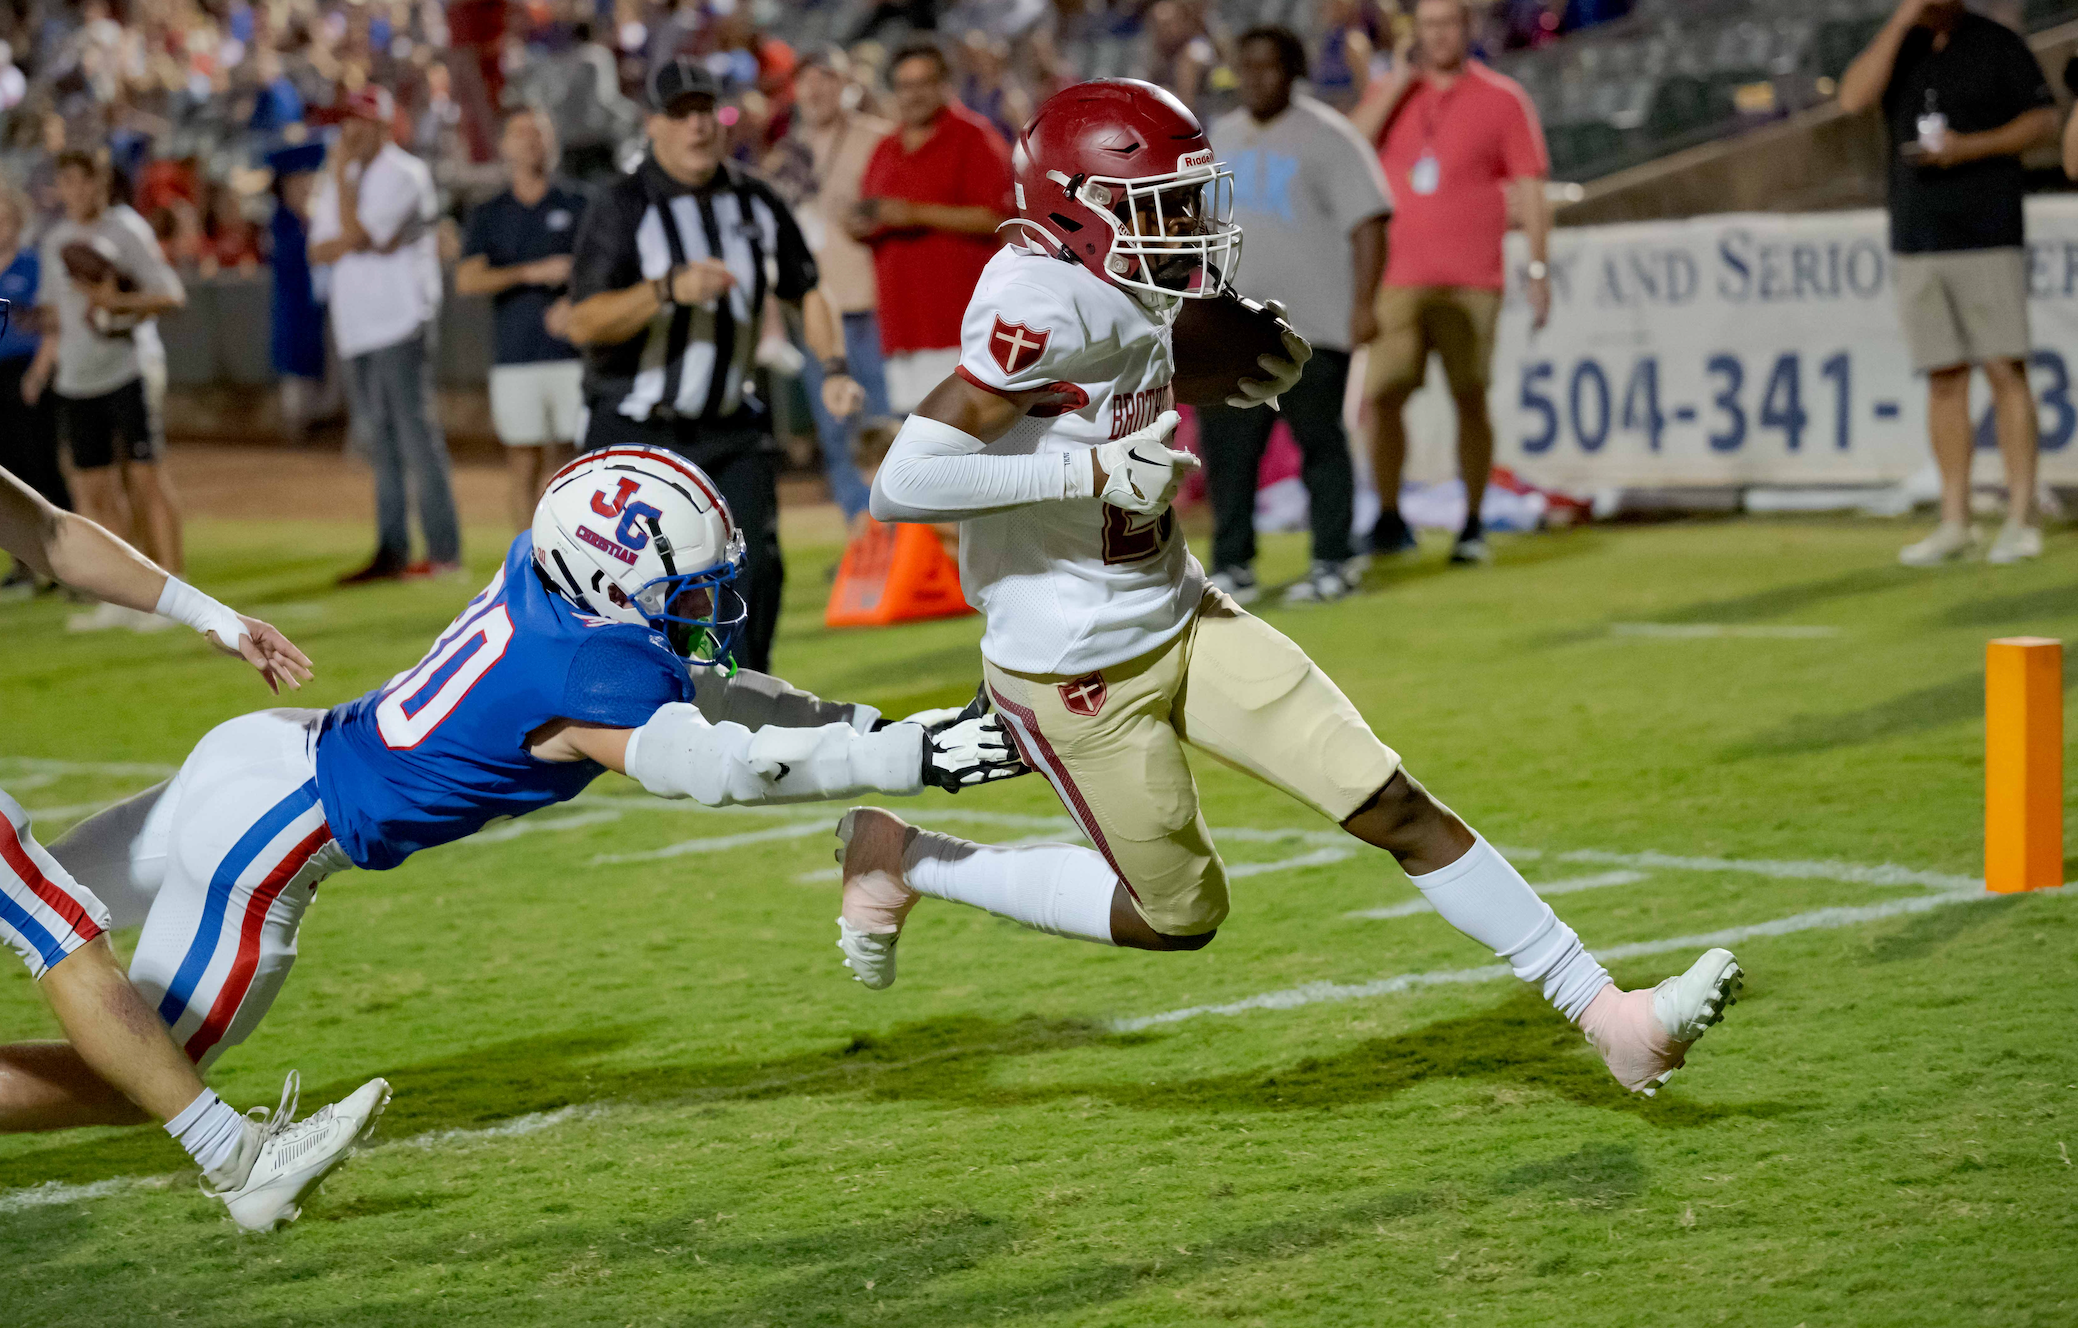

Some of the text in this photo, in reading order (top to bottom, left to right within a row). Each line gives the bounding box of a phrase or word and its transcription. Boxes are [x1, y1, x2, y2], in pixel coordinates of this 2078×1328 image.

[1599, 249, 1698, 304] AND
[1716, 229, 1884, 302] SERIO
[575, 525, 639, 566] CHRISTIAN
[590, 476, 664, 552] JC
